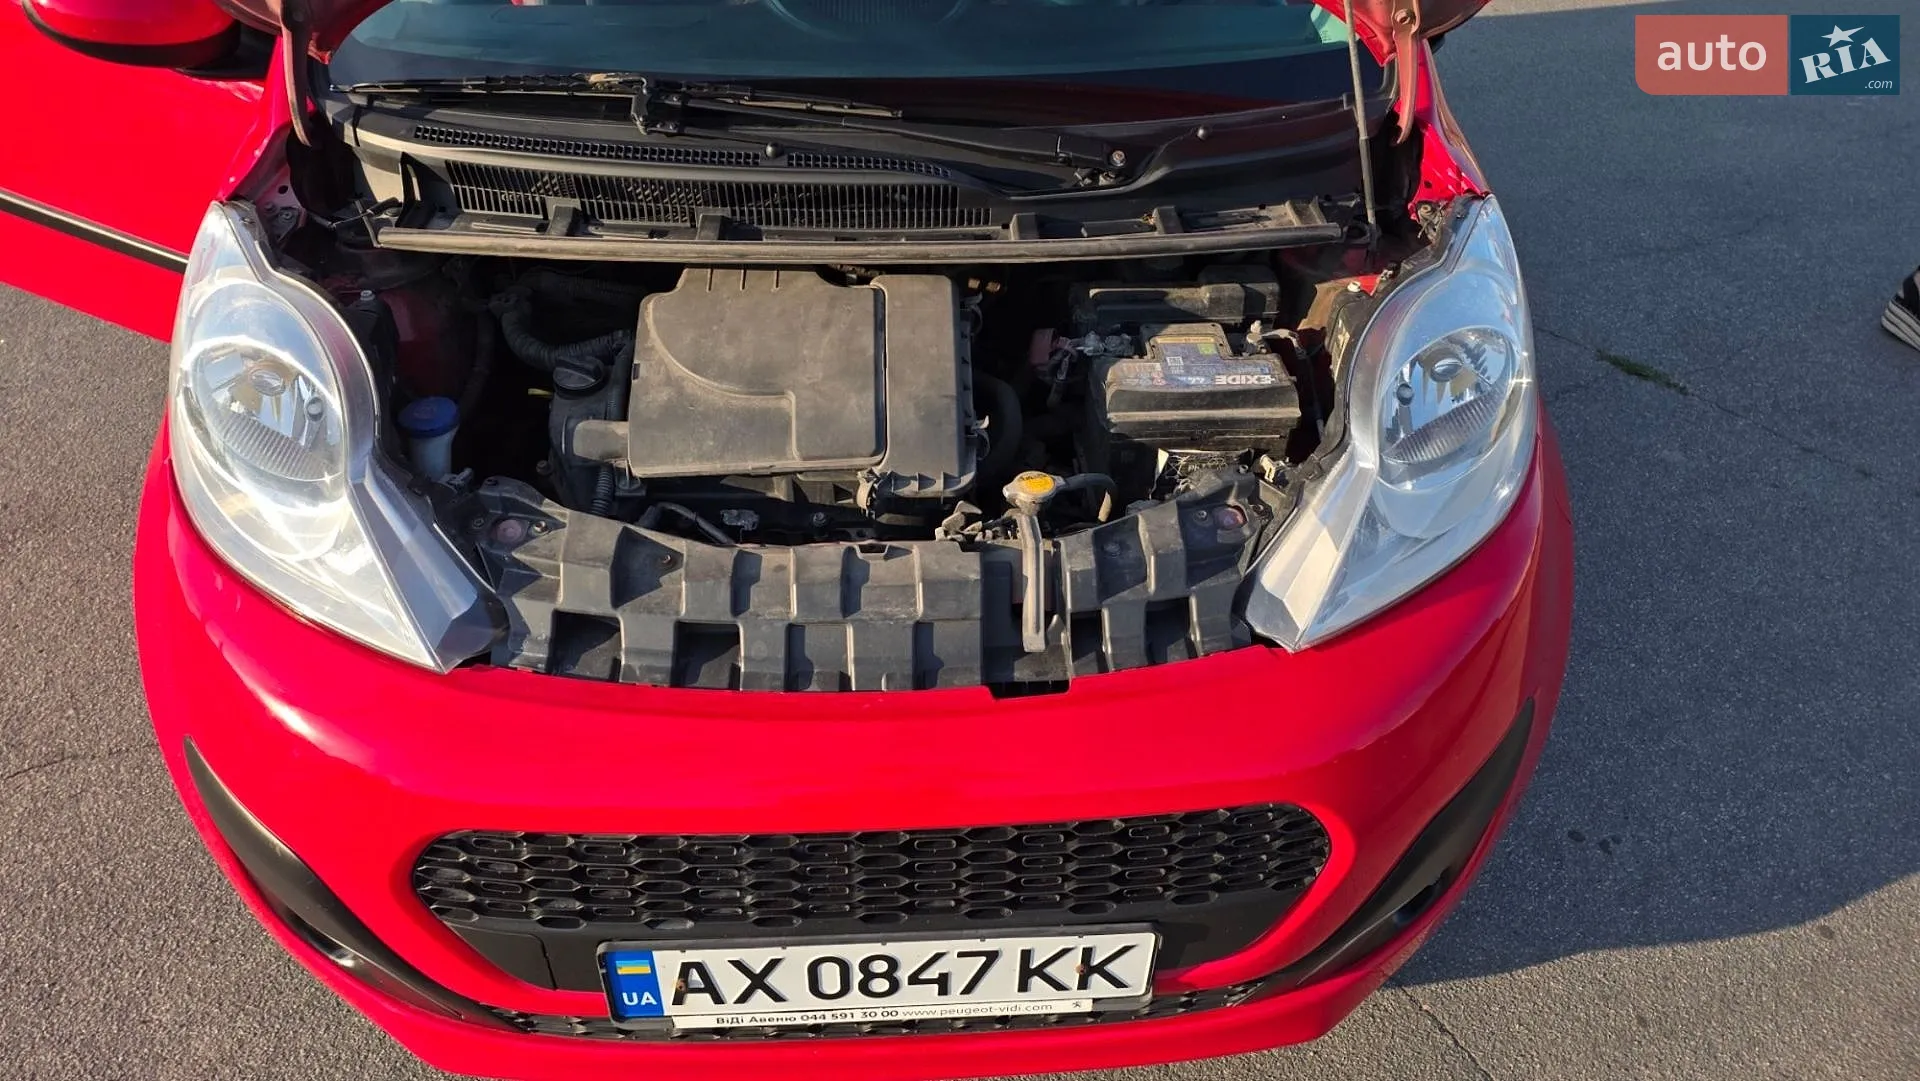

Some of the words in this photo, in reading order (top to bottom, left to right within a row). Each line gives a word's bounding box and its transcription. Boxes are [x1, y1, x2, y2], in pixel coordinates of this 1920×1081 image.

[1214, 374, 1276, 386] EXIDE
[671, 956, 788, 1006] AX
[806, 949, 1002, 1001] 0847
[1017, 944, 1139, 993] KK
[621, 991, 658, 1007] UA
[749, 1015, 797, 1024] Авеню
[800, 1013, 826, 1022] 044
[831, 1012, 855, 1021] 591
[860, 1010, 877, 1019] 30
[880, 1009, 899, 1018] 00
[902, 1002, 1053, 1017] www.peugeot-vidi.com
